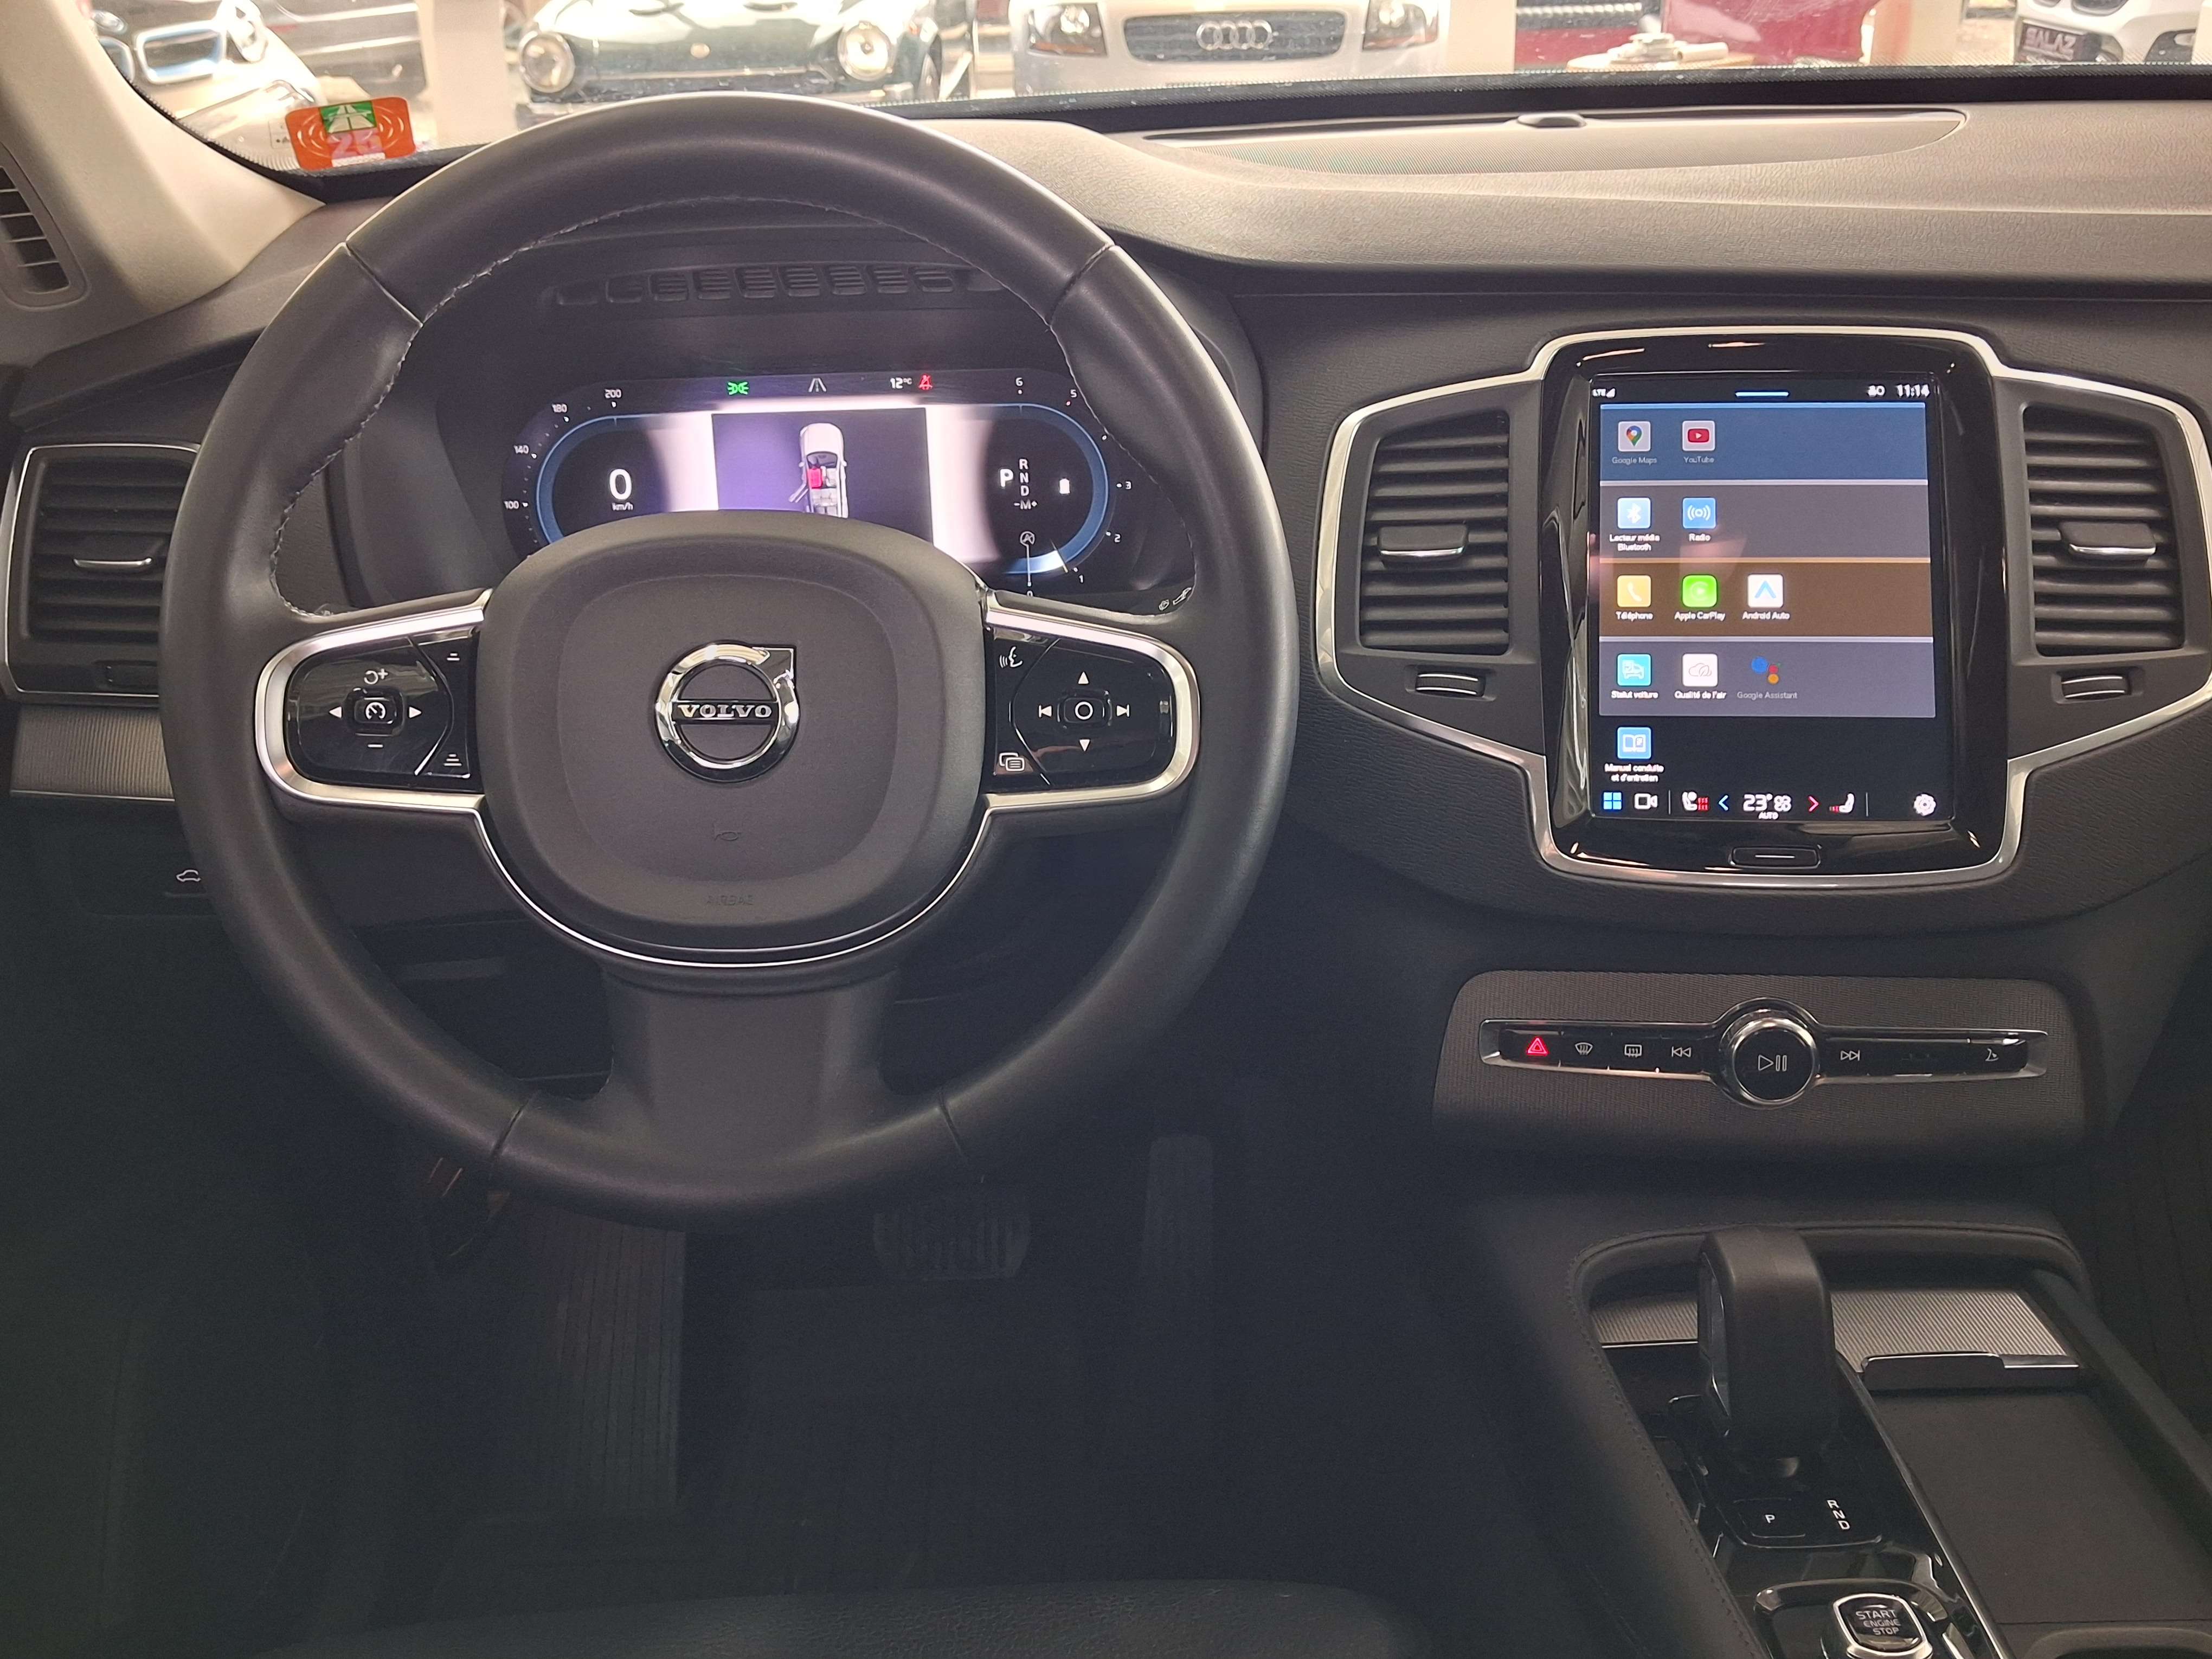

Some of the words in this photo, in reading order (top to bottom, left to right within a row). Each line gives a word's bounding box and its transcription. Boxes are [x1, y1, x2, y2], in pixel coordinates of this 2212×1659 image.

[1015, 377, 1023, 387] 6
[605, 389, 622, 398] 200
[1070, 389, 1077, 398] 5
[1896, 384, 1930, 397] 11:14
[552, 403, 568, 413] 180
[515, 444, 529, 454] 140
[1612, 456, 1637, 465] Google
[1638, 456, 1657, 465] Maps
[1683, 455, 1714, 464] YouTube
[1019, 459, 1028, 470] R
[1000, 468, 1014, 487] P
[1020, 472, 1029, 483] N
[609, 468, 632, 500] 0
[1126, 481, 1131, 490] 3
[1020, 485, 1030, 496] D
[504, 500, 519, 510] 100
[612, 502, 633, 510] km/h
[1114, 534, 1121, 542] 2
[1609, 533, 1637, 542] Lecteur
[1637, 533, 1660, 542] média
[1689, 533, 1711, 542] Radio
[1617, 543, 1652, 551] Bluetooth
[1616, 610, 1654, 621] Téléphone
[1674, 611, 1696, 621] Apple
[1697, 611, 1726, 621] CarPlay
[1742, 611, 1771, 620] Android
[1772, 611, 1790, 620] Auto
[1611, 691, 1632, 699] Statut
[1634, 691, 1659, 699] voiture
[1674, 691, 1701, 699] Qualité
[1702, 691, 1711, 699] de
[1712, 691, 1727, 699] l'air
[1737, 691, 1763, 700] Google
[1765, 691, 1798, 699] Assistant
[678, 704, 772, 718] VOLVO
[1604, 763, 1632, 773] Manuel
[1632, 764, 1664, 773] conduite
[1611, 774, 1619, 782] et
[1758, 812, 1779, 820] AUTO
[1827, 1500, 1839, 1508] R
[1765, 1514, 1775, 1523] P
[1832, 1510, 1845, 1519] N
[1838, 1520, 1850, 1530] D
[1855, 1609, 1897, 1620] START
[1863, 1619, 1901, 1628] ENGINE
[1872, 1627, 1899, 1635] STOP
